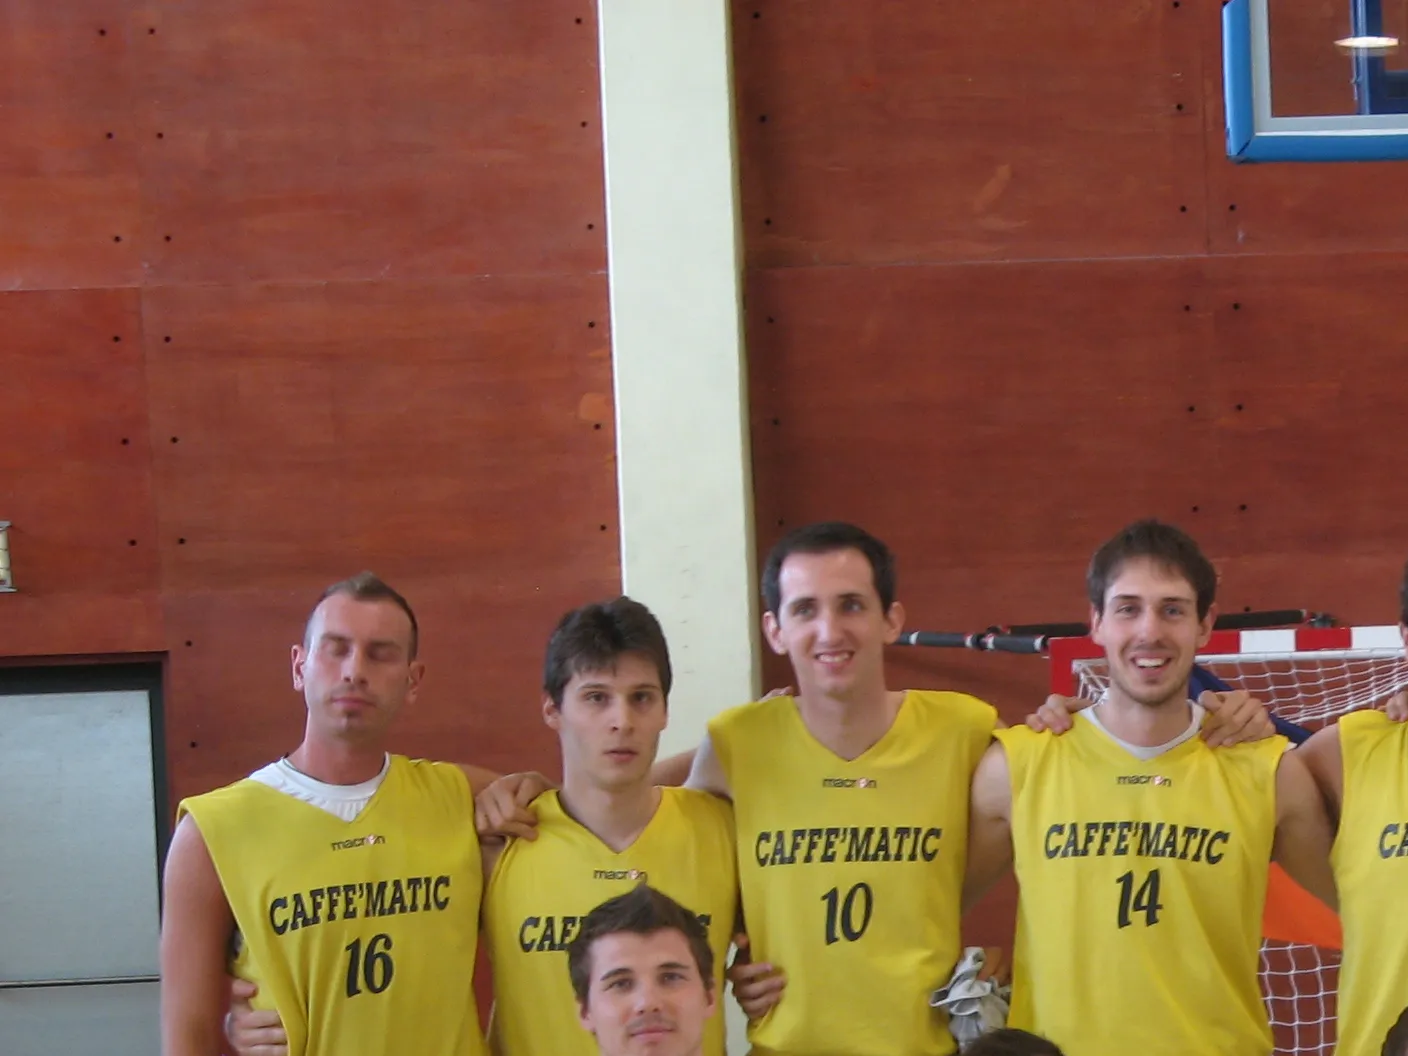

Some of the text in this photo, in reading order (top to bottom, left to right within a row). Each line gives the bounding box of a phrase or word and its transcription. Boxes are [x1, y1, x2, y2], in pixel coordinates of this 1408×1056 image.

[822, 778, 877, 788] macron
[1117, 775, 1172, 787] macron
[331, 835, 386, 851] macron
[755, 826, 942, 867] CAFFE'MATIC
[1044, 821, 1230, 865] CAFFE'MATIC
[593, 869, 648, 885] macron
[269, 875, 450, 937] CAFFE'MATIC
[821, 882, 873, 946] 10
[1116, 868, 1163, 929] 14
[345, 933, 394, 998] 16
